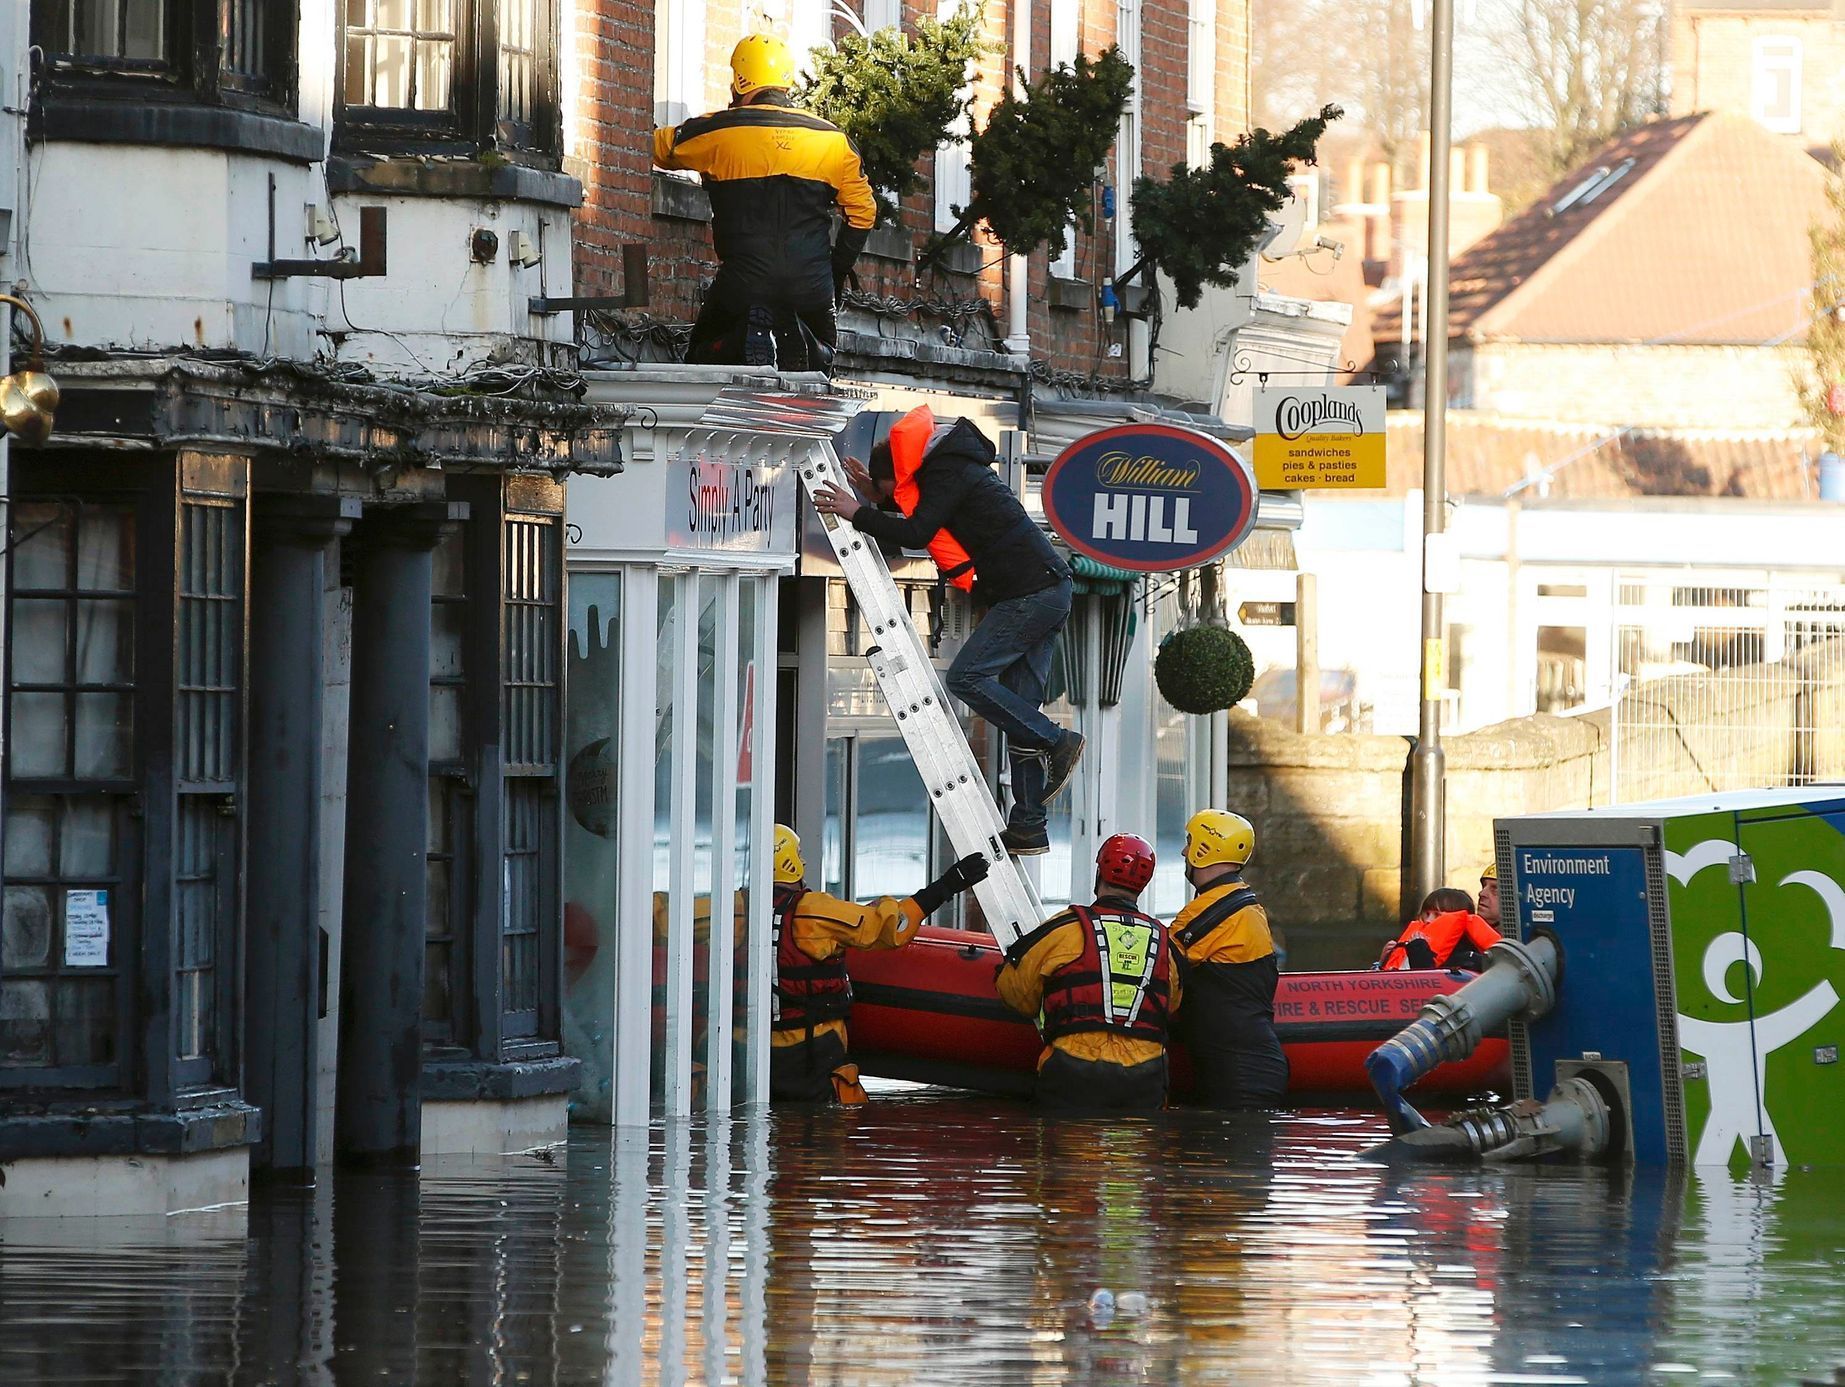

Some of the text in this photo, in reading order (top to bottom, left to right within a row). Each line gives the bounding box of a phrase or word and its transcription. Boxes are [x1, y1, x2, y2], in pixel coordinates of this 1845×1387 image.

[1275, 393, 1363, 440] Cooplands
[1288, 447, 1351, 457] sandwiches
[1097, 451, 1201, 490] William
[1282, 460, 1357, 471] pies & pasties
[1284, 473, 1355, 483] cakes bread
[688, 466, 775, 549] Simply A Party
[1092, 492, 1198, 544] HILL
[1524, 853, 1610, 875] Environment
[1527, 883, 1575, 908] Agency
[1287, 978, 1442, 993] NORTH YORKSHIRE
[1308, 1002, 1321, 1016] &
[1325, 1000, 1391, 1015] RESCUE
